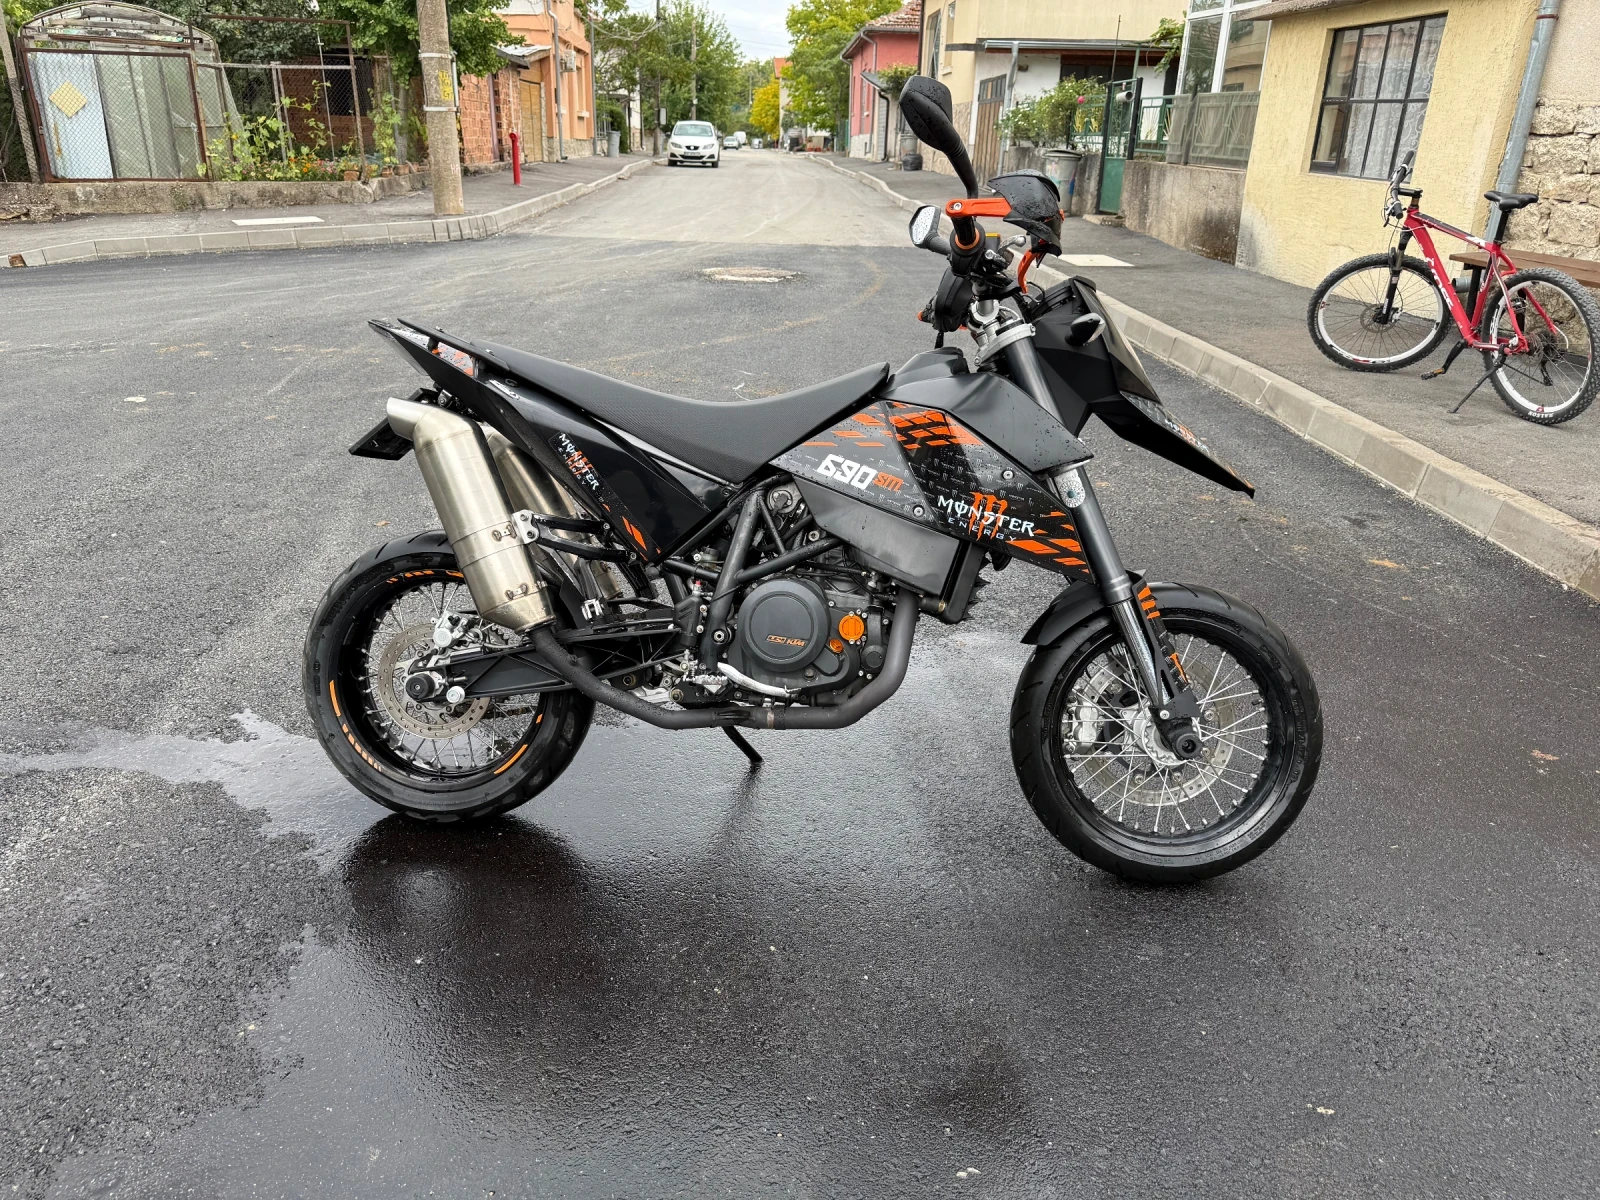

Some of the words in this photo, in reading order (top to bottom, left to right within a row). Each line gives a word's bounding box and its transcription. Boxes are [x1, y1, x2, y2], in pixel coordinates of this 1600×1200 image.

[559, 433, 599, 490] MONSTER
[817, 453, 878, 490] 690
[938, 495, 1034, 537] MONSTER
[948, 517, 1016, 541] ENERGY
